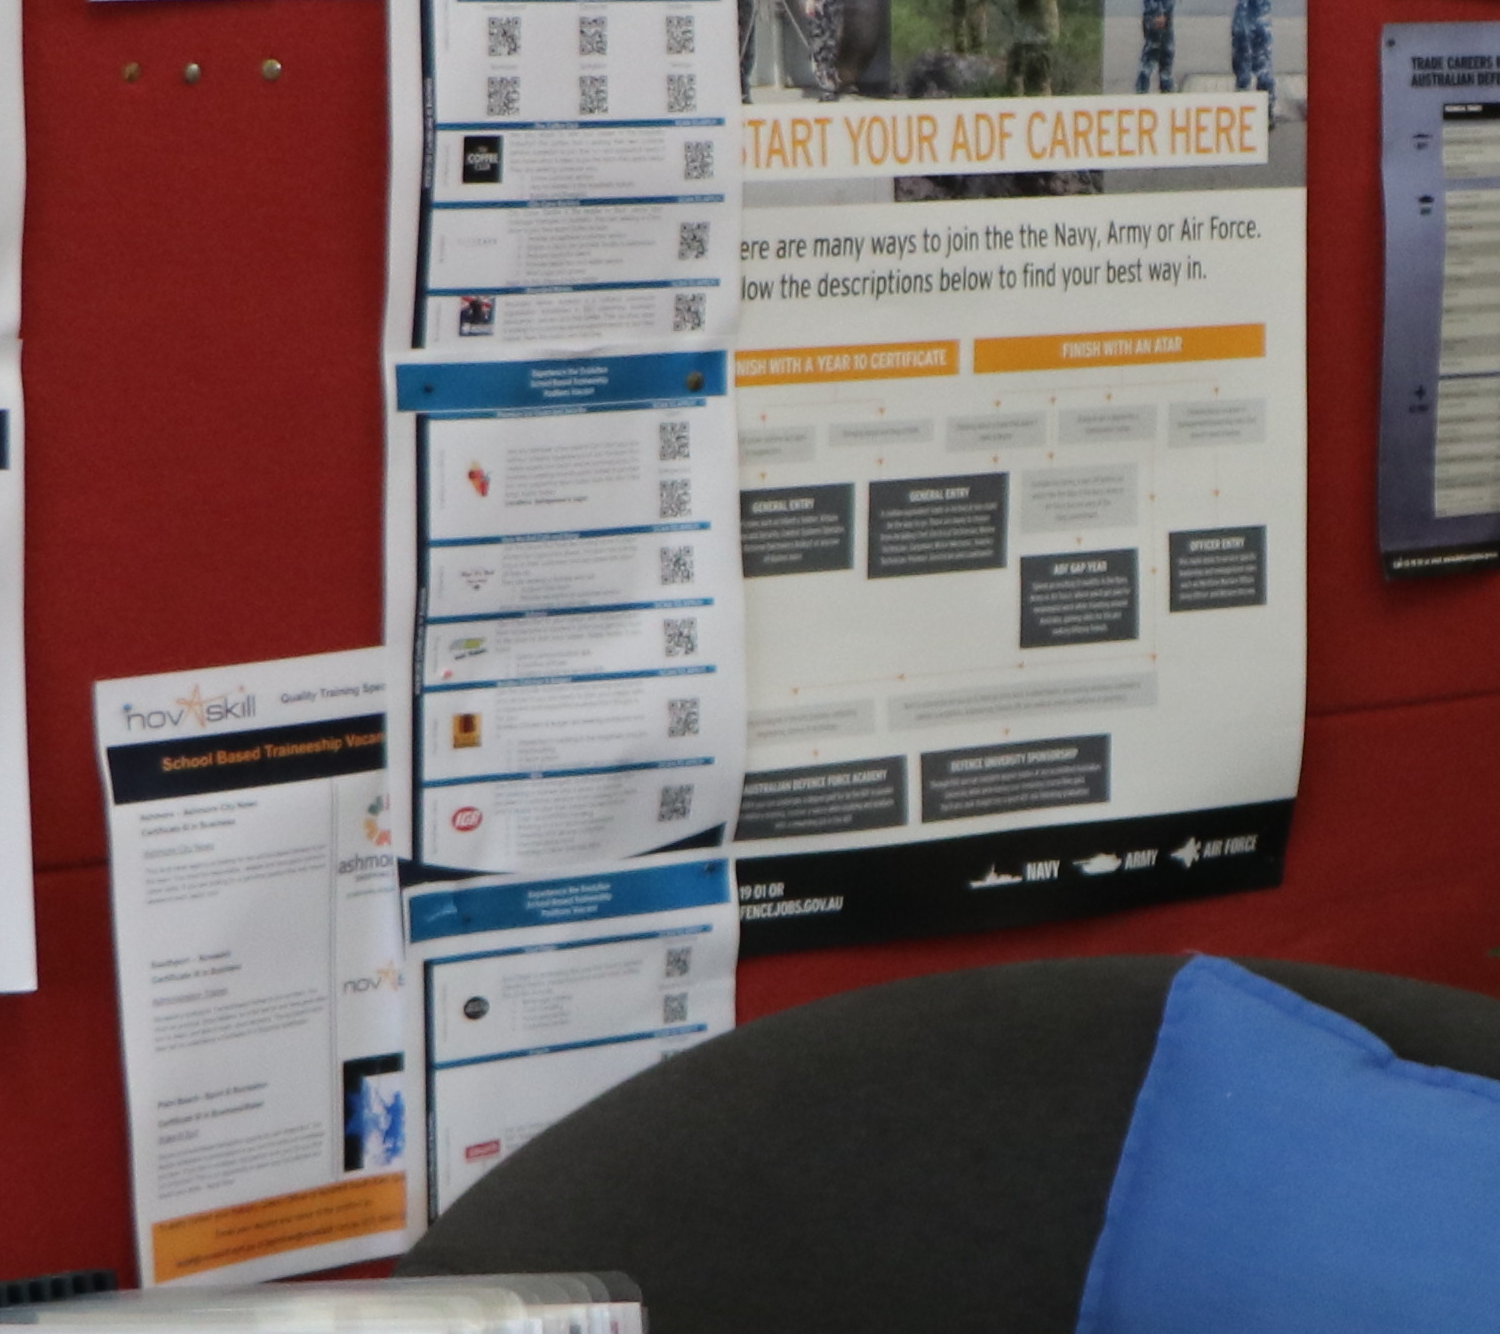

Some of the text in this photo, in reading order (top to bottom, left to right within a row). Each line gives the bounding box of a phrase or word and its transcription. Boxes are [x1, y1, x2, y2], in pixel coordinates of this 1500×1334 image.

[845, 114, 938, 165] YOUR
[951, 112, 1015, 161] ADF
[1026, 109, 1157, 160] CAREER
[1171, 106, 1256, 155] HERE
[1204, 835, 1257, 858] AIR FORCE
[1026, 861, 1060, 882] NAVY
[1125, 851, 1158, 870] ARMY
